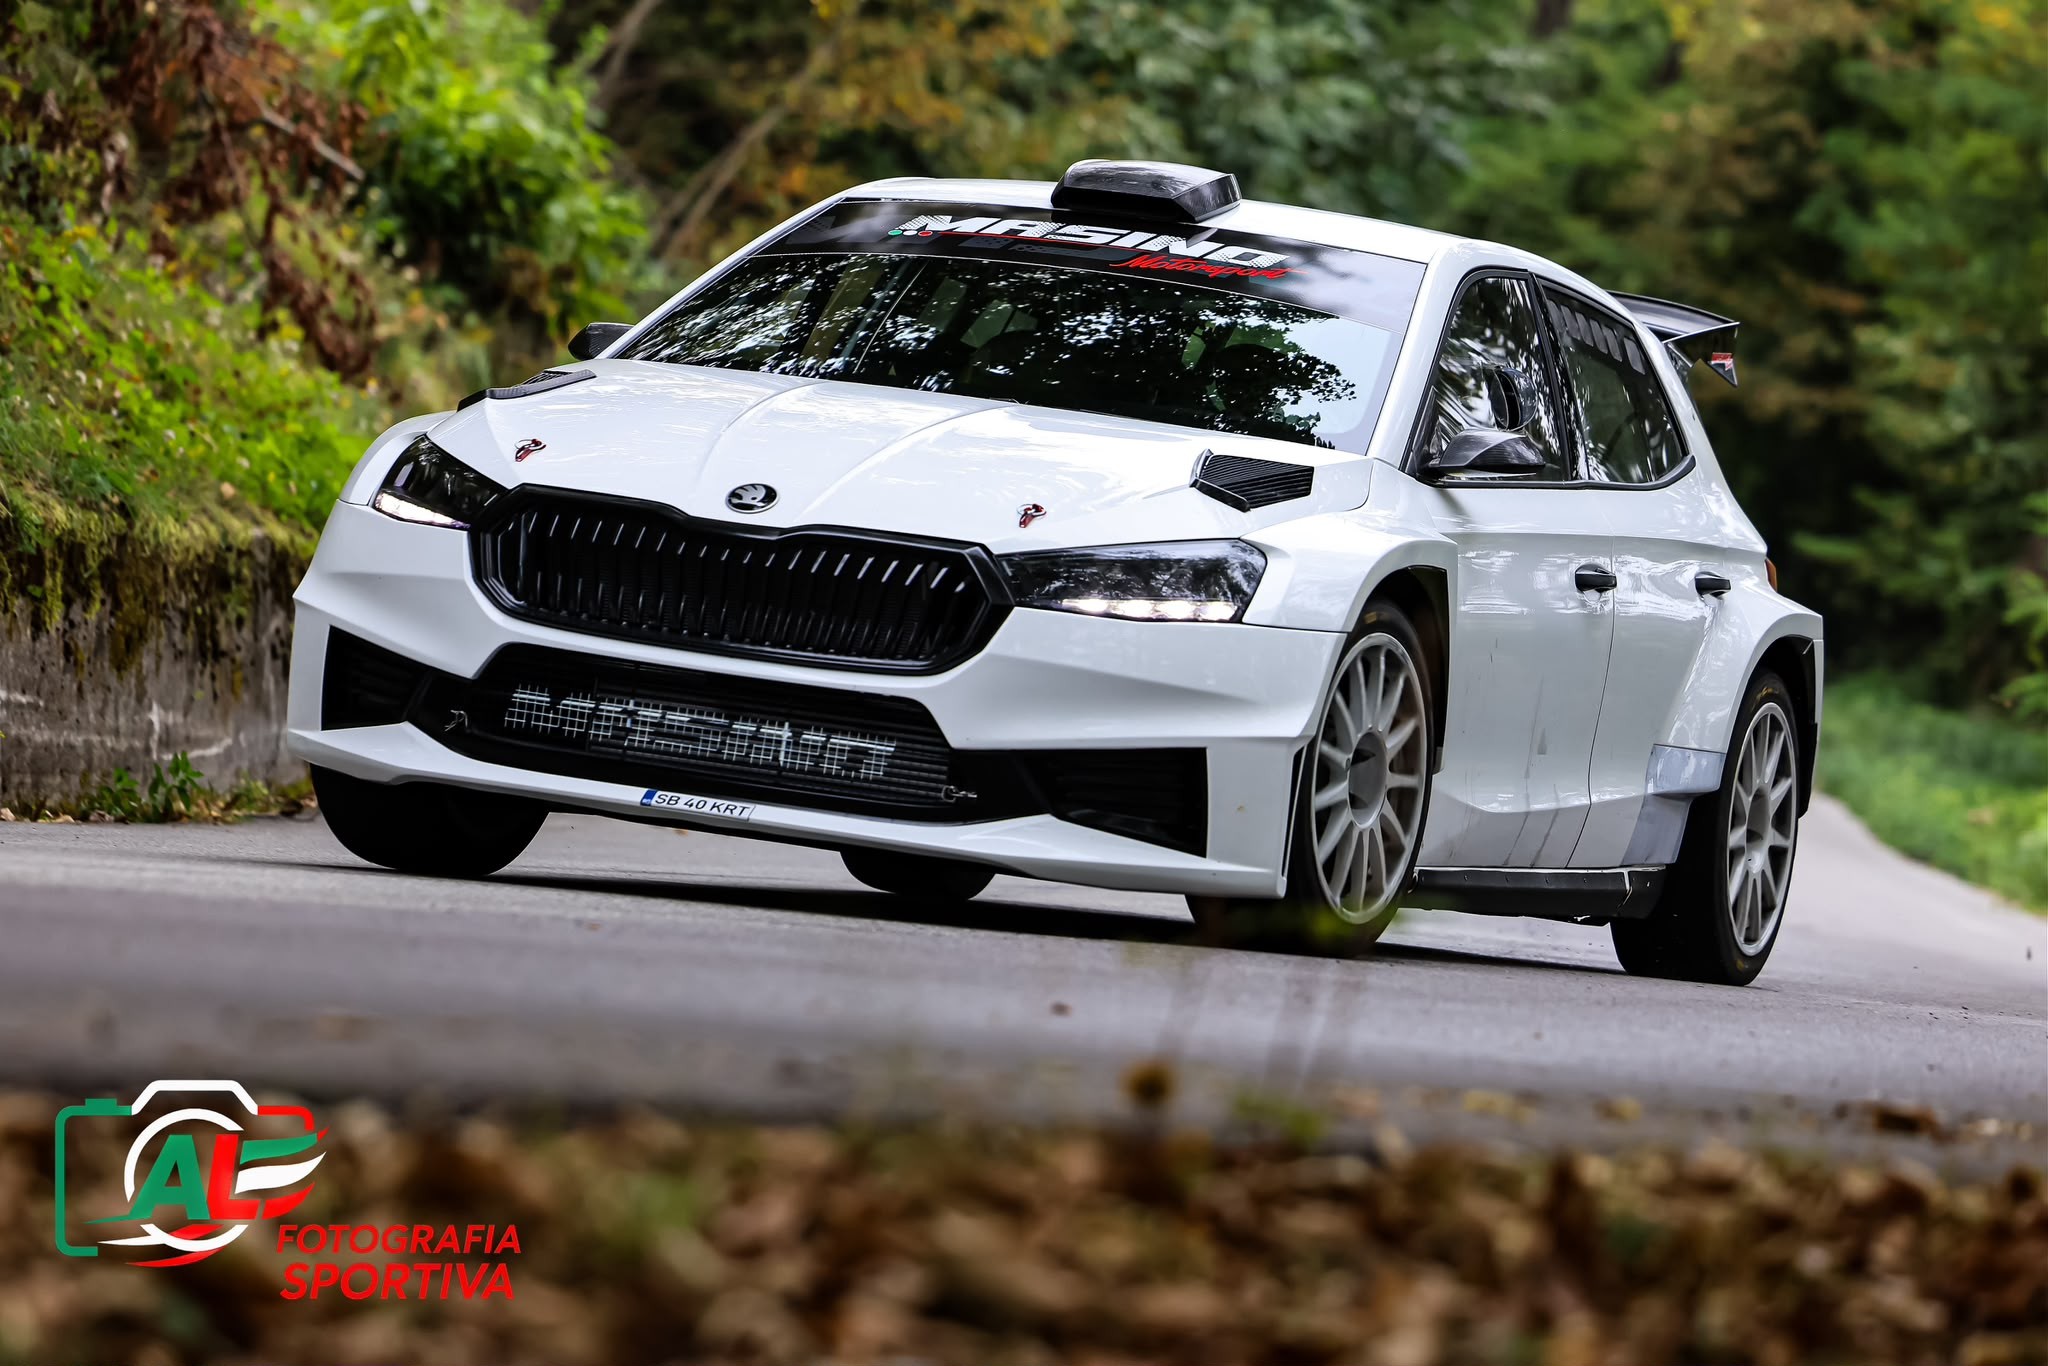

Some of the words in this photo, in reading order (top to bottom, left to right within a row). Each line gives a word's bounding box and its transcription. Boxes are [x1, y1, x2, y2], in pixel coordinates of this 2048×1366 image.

[897, 215, 1290, 269] MASINO
[1109, 255, 1308, 279] Motorsport
[655, 793, 680, 806] SB
[683, 798, 708, 810] 40
[709, 801, 750, 817] KRT
